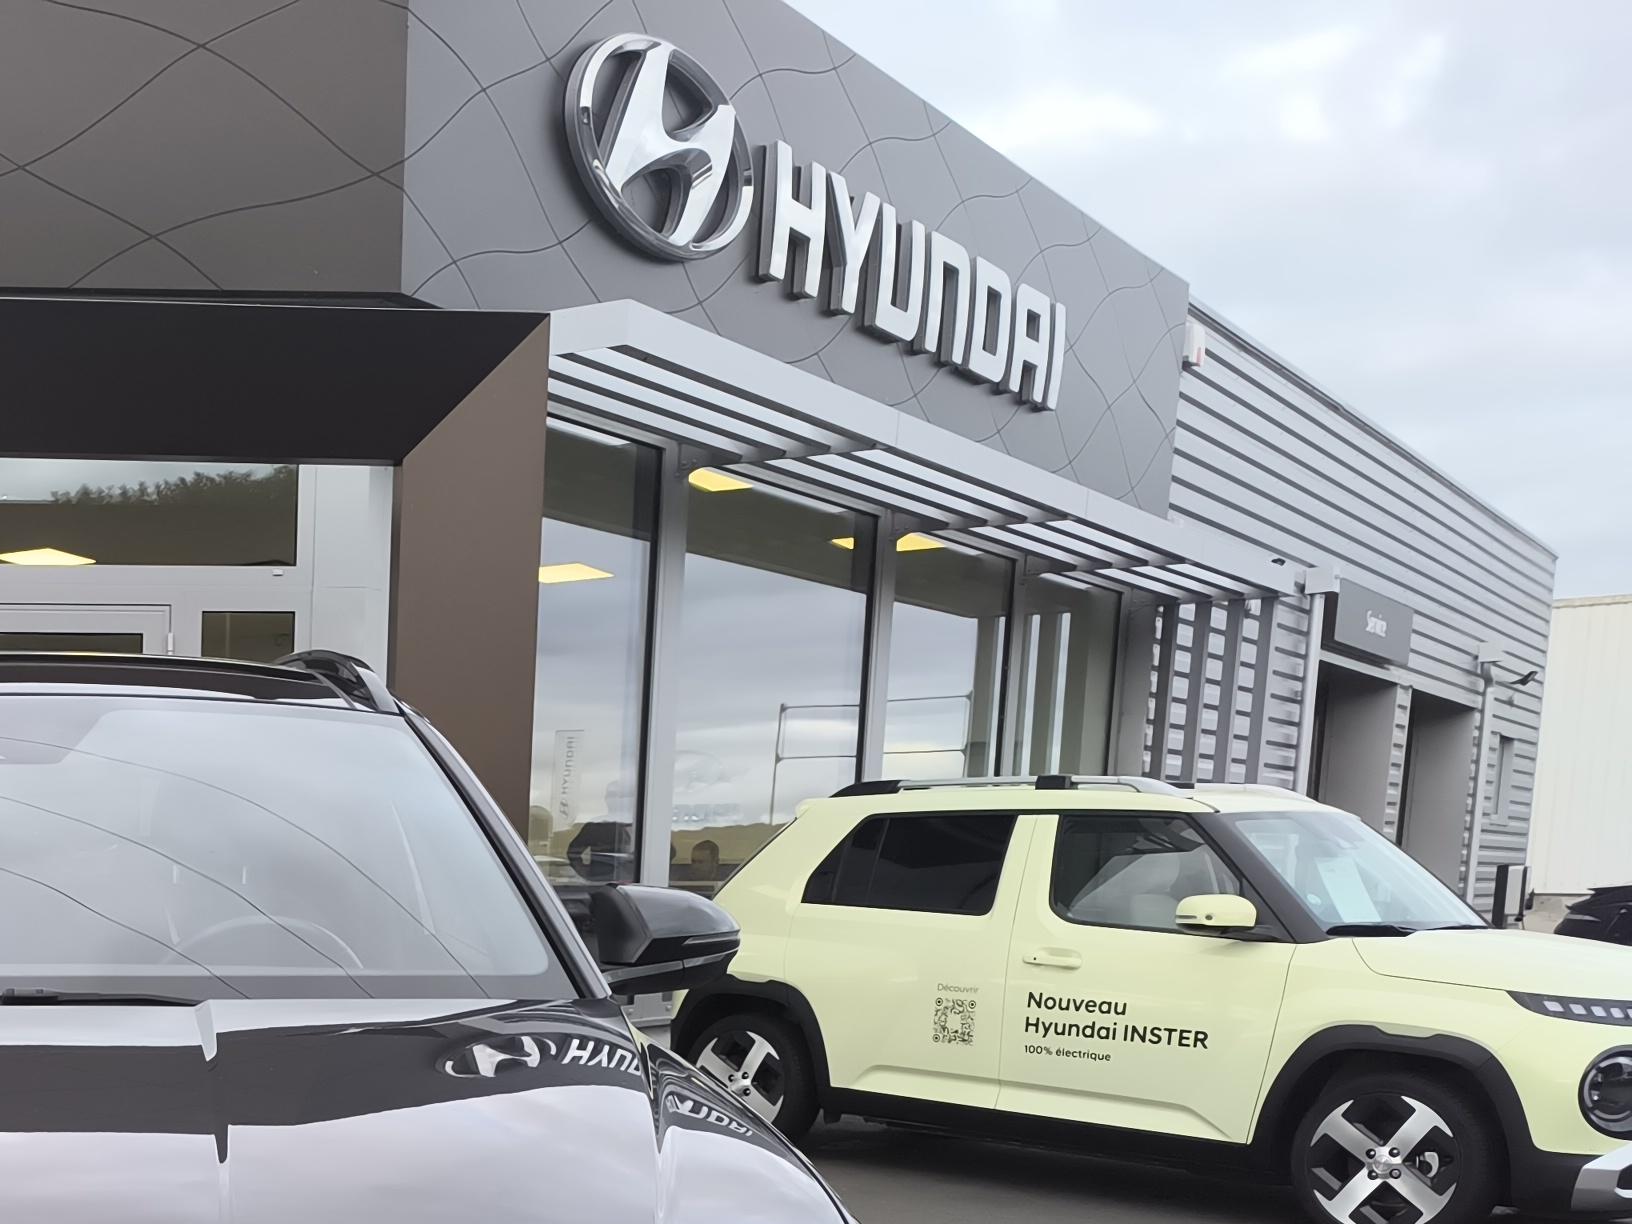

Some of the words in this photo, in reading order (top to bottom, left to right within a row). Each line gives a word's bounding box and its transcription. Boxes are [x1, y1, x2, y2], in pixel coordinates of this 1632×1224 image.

[760, 139, 1067, 411] HYUNDAI
[1026, 991, 1128, 1016] Nouveau
[1024, 1016, 1118, 1041] Hyundai
[1122, 1024, 1209, 1050] INSTER
[1024, 1044, 1053, 1056] 100%
[1055, 1047, 1112, 1062] électrique
